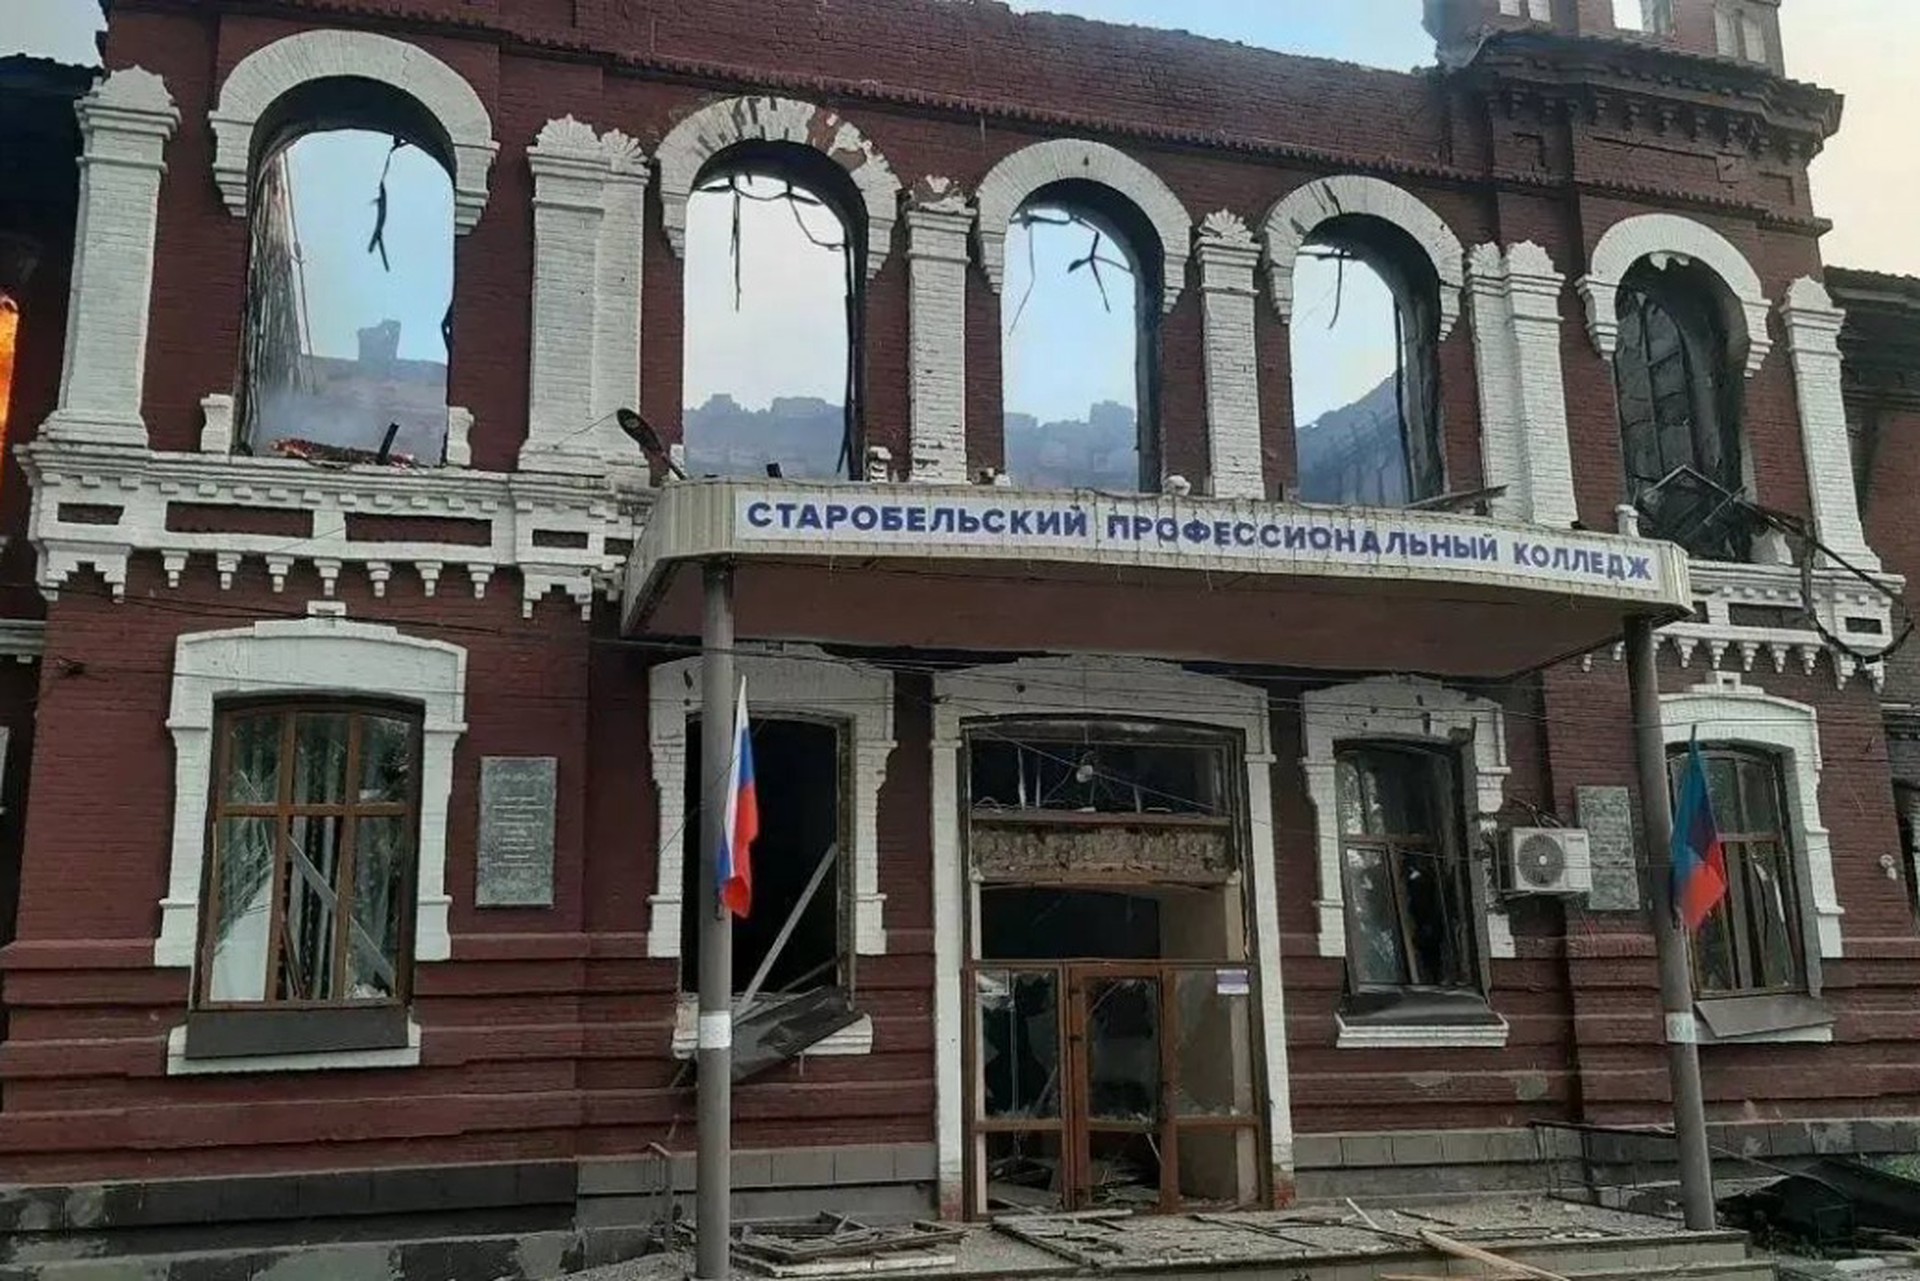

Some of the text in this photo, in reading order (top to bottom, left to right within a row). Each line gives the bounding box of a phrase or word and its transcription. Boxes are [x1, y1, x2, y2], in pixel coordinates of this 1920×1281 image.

[748, 502, 1651, 580] СТАРОБЕЛЬСКИЙ ПРОФЕССИОНАЛЬНЫЙ КОЛЛЕДЖ
